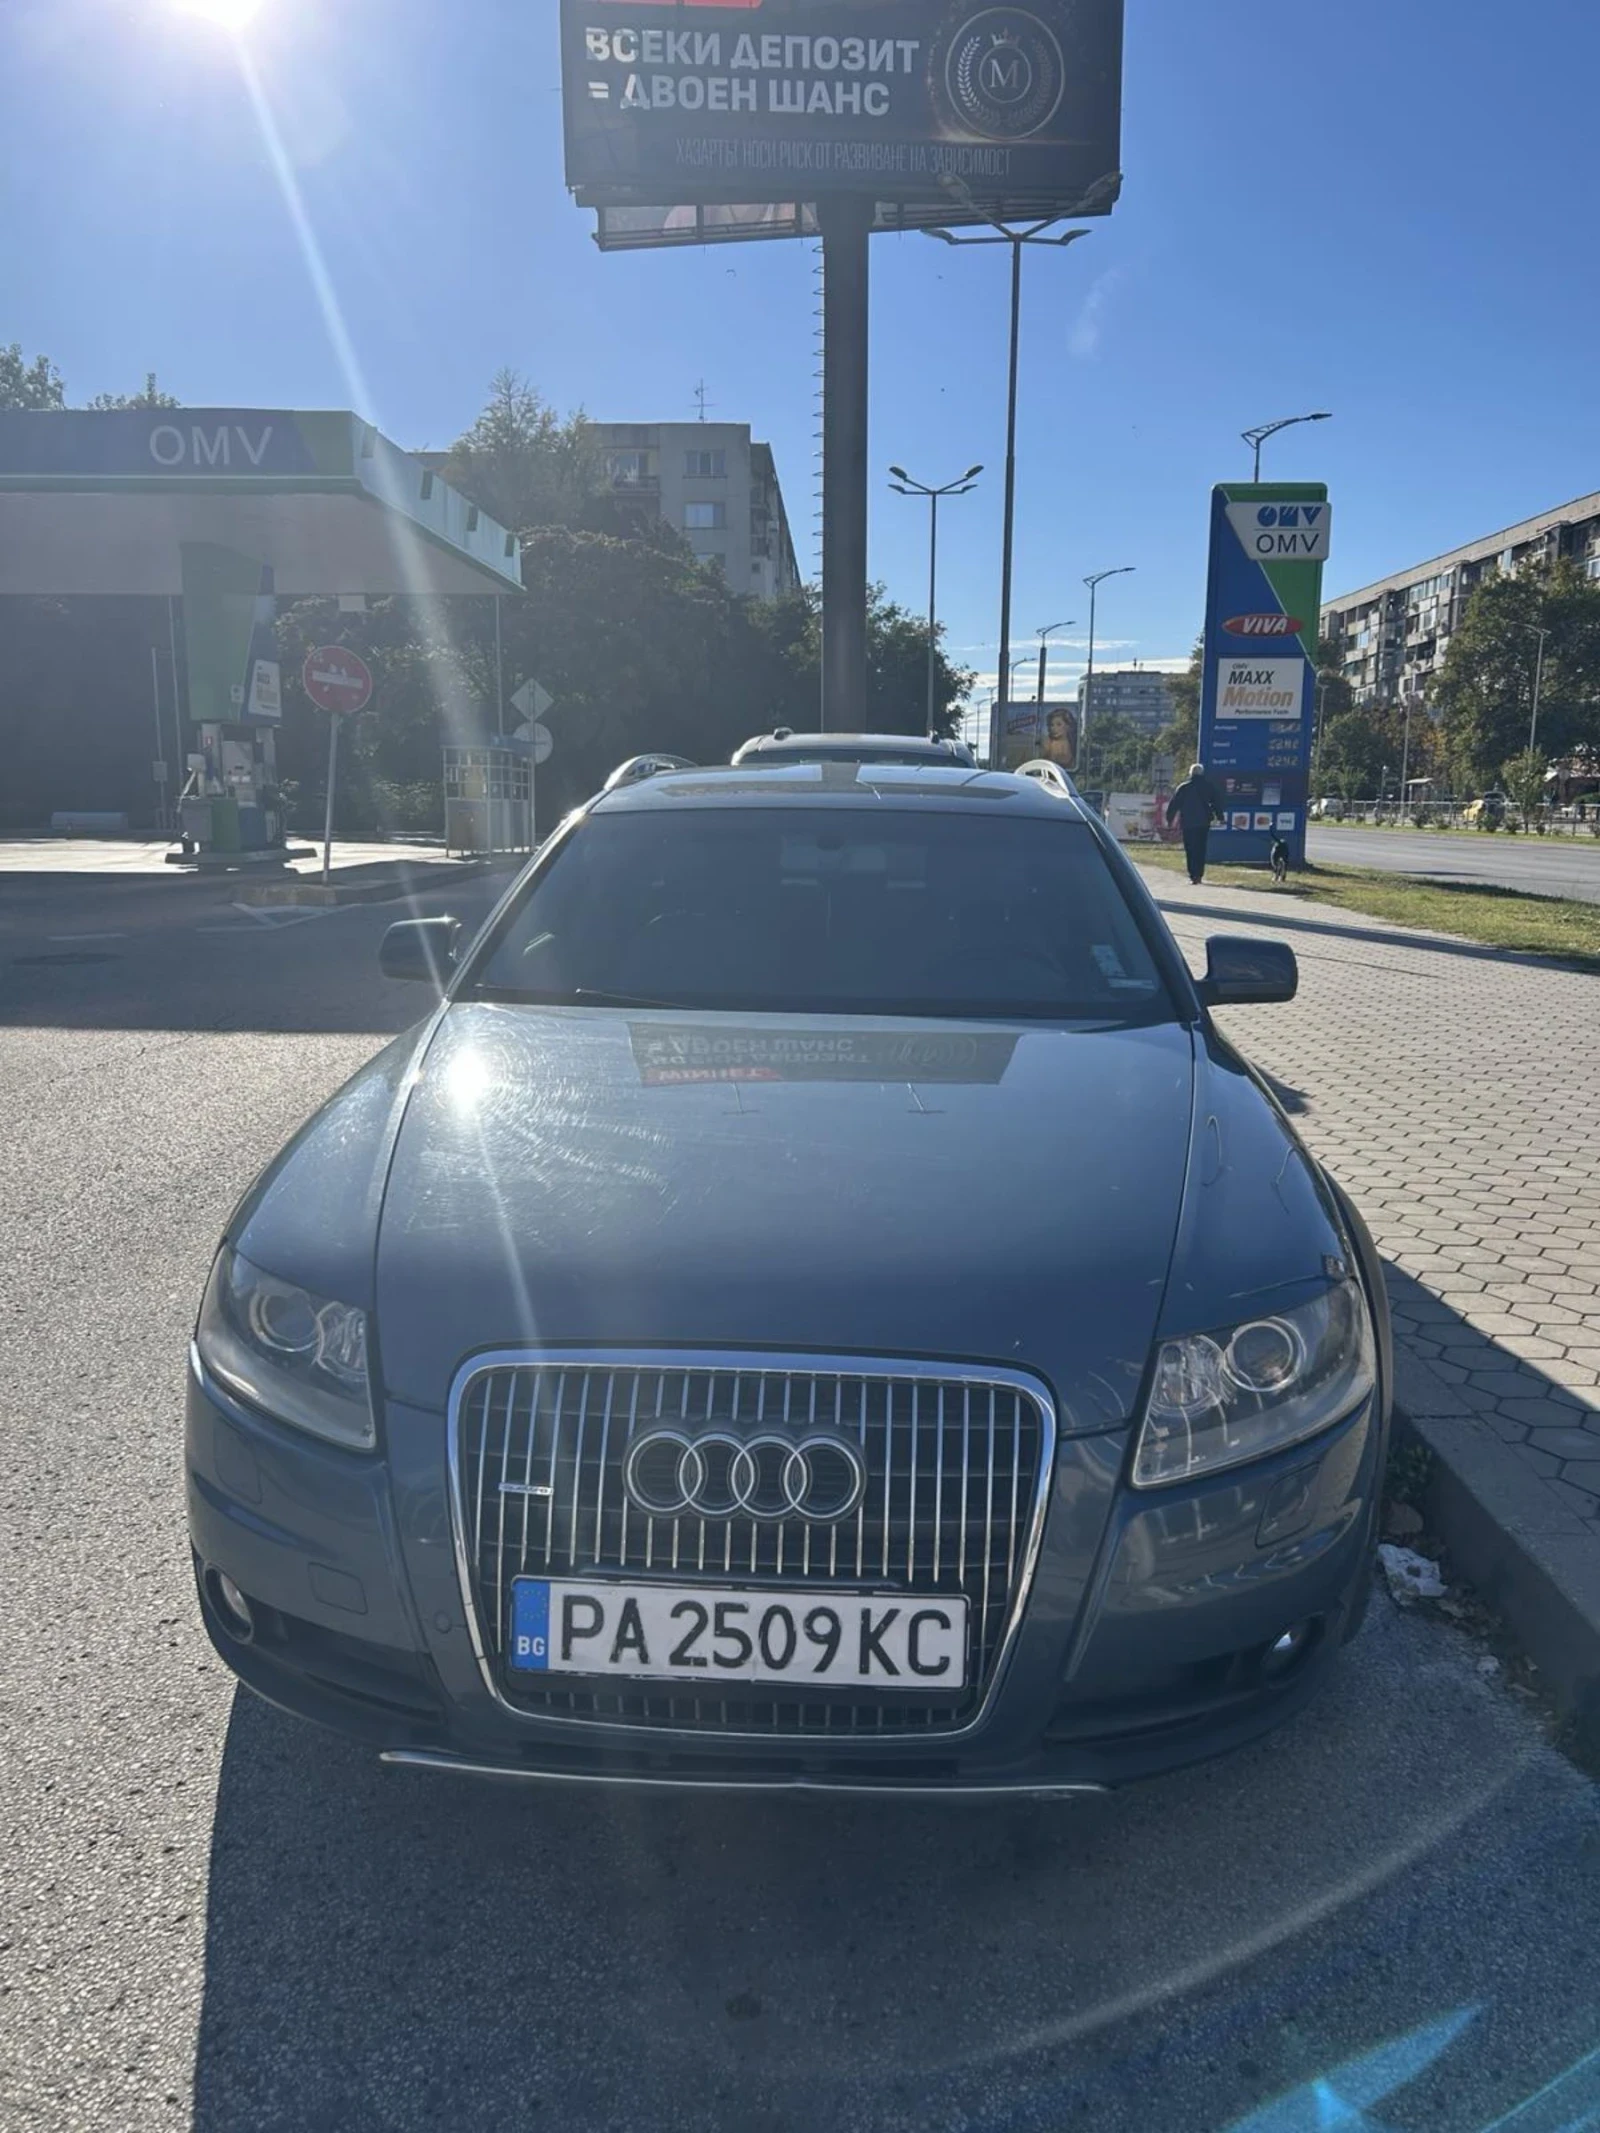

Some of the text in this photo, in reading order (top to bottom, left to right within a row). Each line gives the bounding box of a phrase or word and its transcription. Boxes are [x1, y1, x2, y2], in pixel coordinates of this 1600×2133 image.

[586, 27, 920, 73] ВСЕКИ ДЕПОЗИТ
[988, 58, 1021, 88] M
[620, 74, 757, 112] ДВОЕН
[769, 79, 890, 116] ШАНС
[743, 139, 778, 168] НОСИ
[780, 140, 813, 170] РИСК
[816, 142, 832, 170] ОТ
[834, 142, 908, 172] РАЗВИВАНЕ
[910, 145, 927, 172] НА
[930, 146, 1012, 176] ЗАВИСИМОСТ
[150, 425, 273, 465] OMV
[1256, 533, 1319, 554] OMV
[1242, 616, 1289, 634] VIVA
[1228, 670, 1276, 685] MAXX
[1222, 686, 1295, 707] Motion
[517, 1636, 545, 1657] BG
[668, 1598, 843, 1674] 2509
